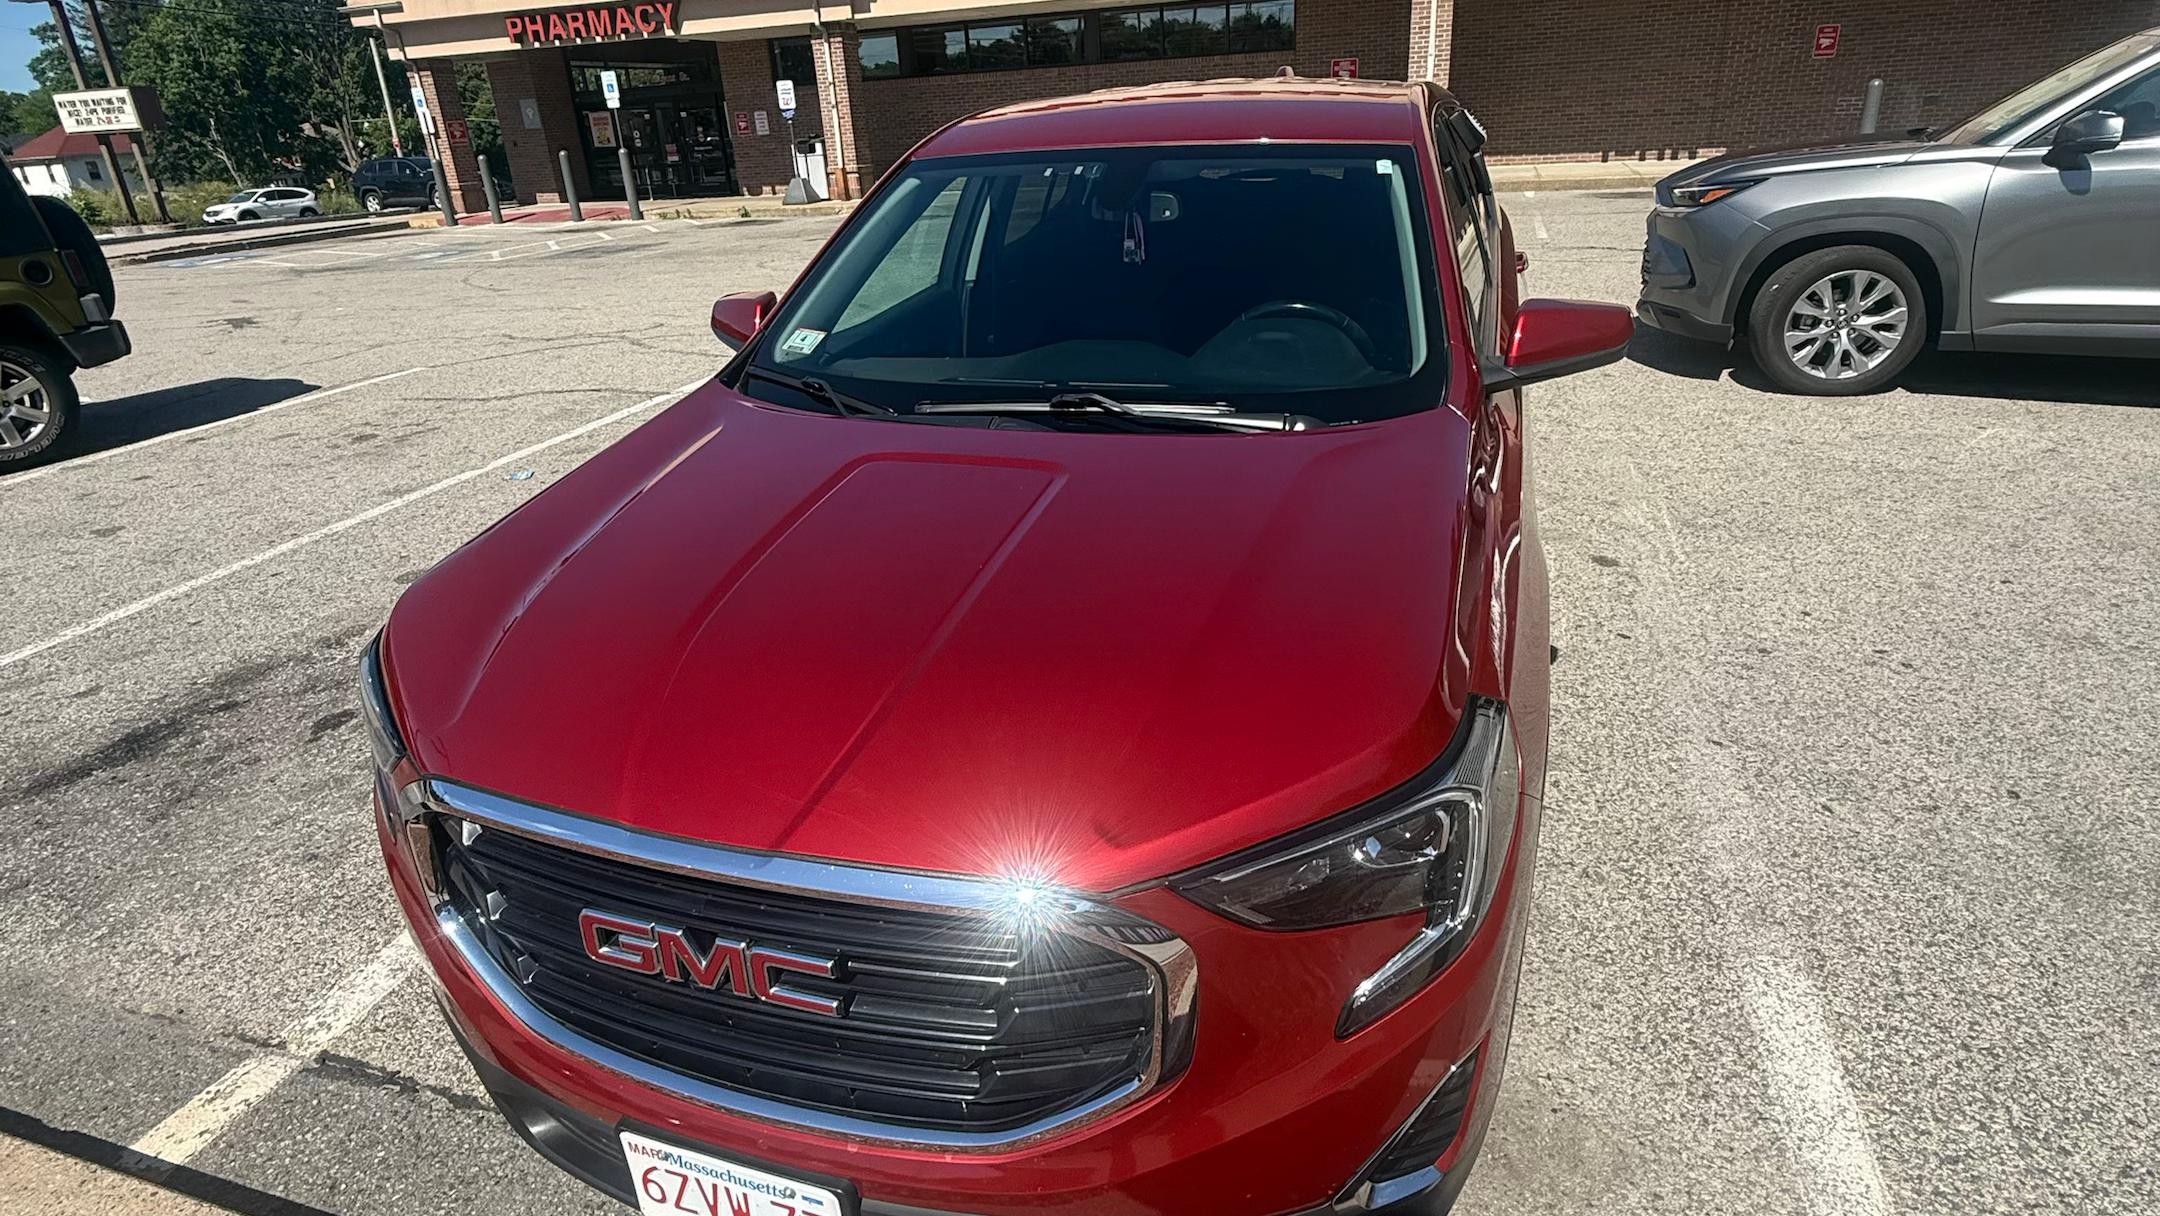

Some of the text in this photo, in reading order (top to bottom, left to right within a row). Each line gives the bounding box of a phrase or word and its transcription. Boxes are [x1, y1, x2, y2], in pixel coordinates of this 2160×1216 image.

[504, 2, 673, 44] PHARMACY
[578, 907, 844, 1018] GMC
[667, 1151, 787, 1200] Massachusetts
